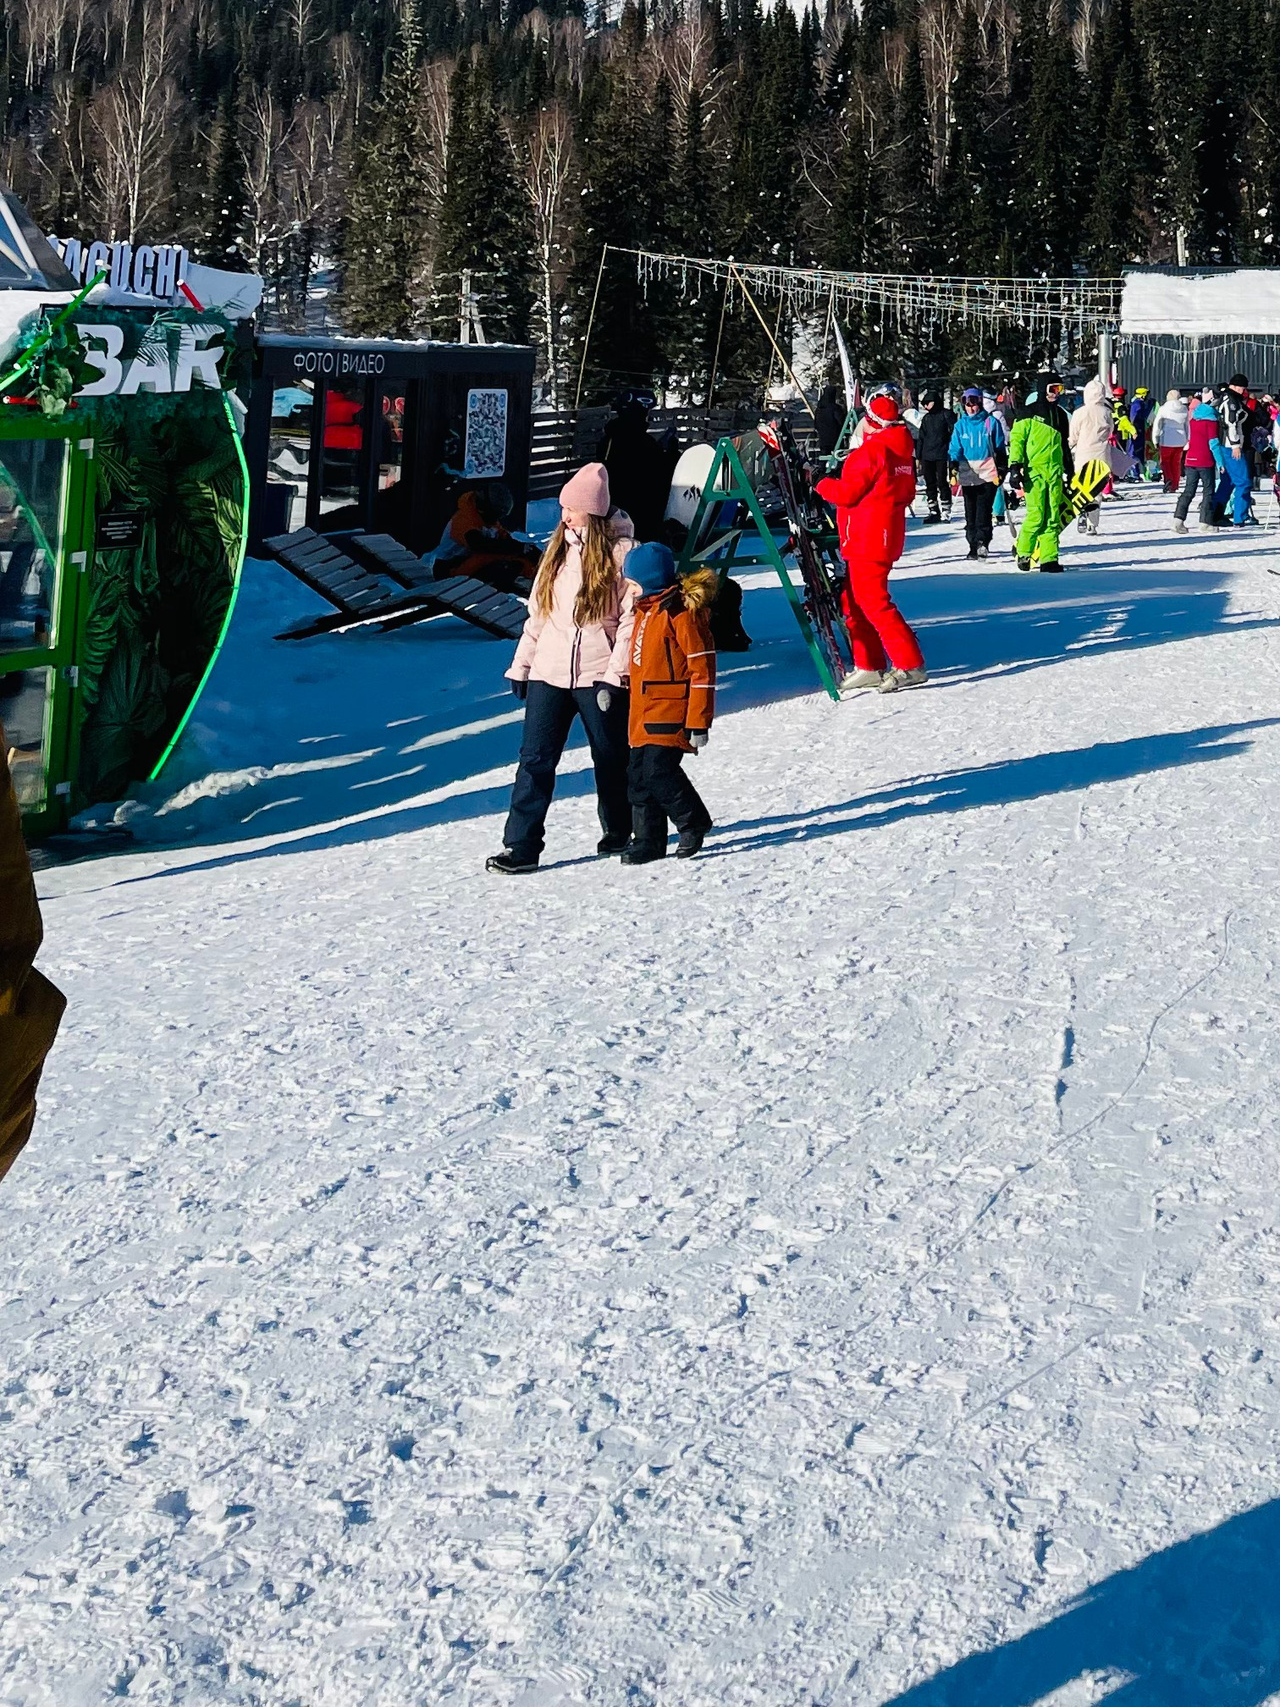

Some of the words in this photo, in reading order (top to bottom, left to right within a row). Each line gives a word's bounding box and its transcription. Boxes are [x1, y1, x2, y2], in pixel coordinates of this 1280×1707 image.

[46, 236, 189, 297] AGUCHI
[73, 323, 225, 396] BAR
[293, 351, 334, 373] ФОТО
[341, 352, 385, 375] ВИДЕО
